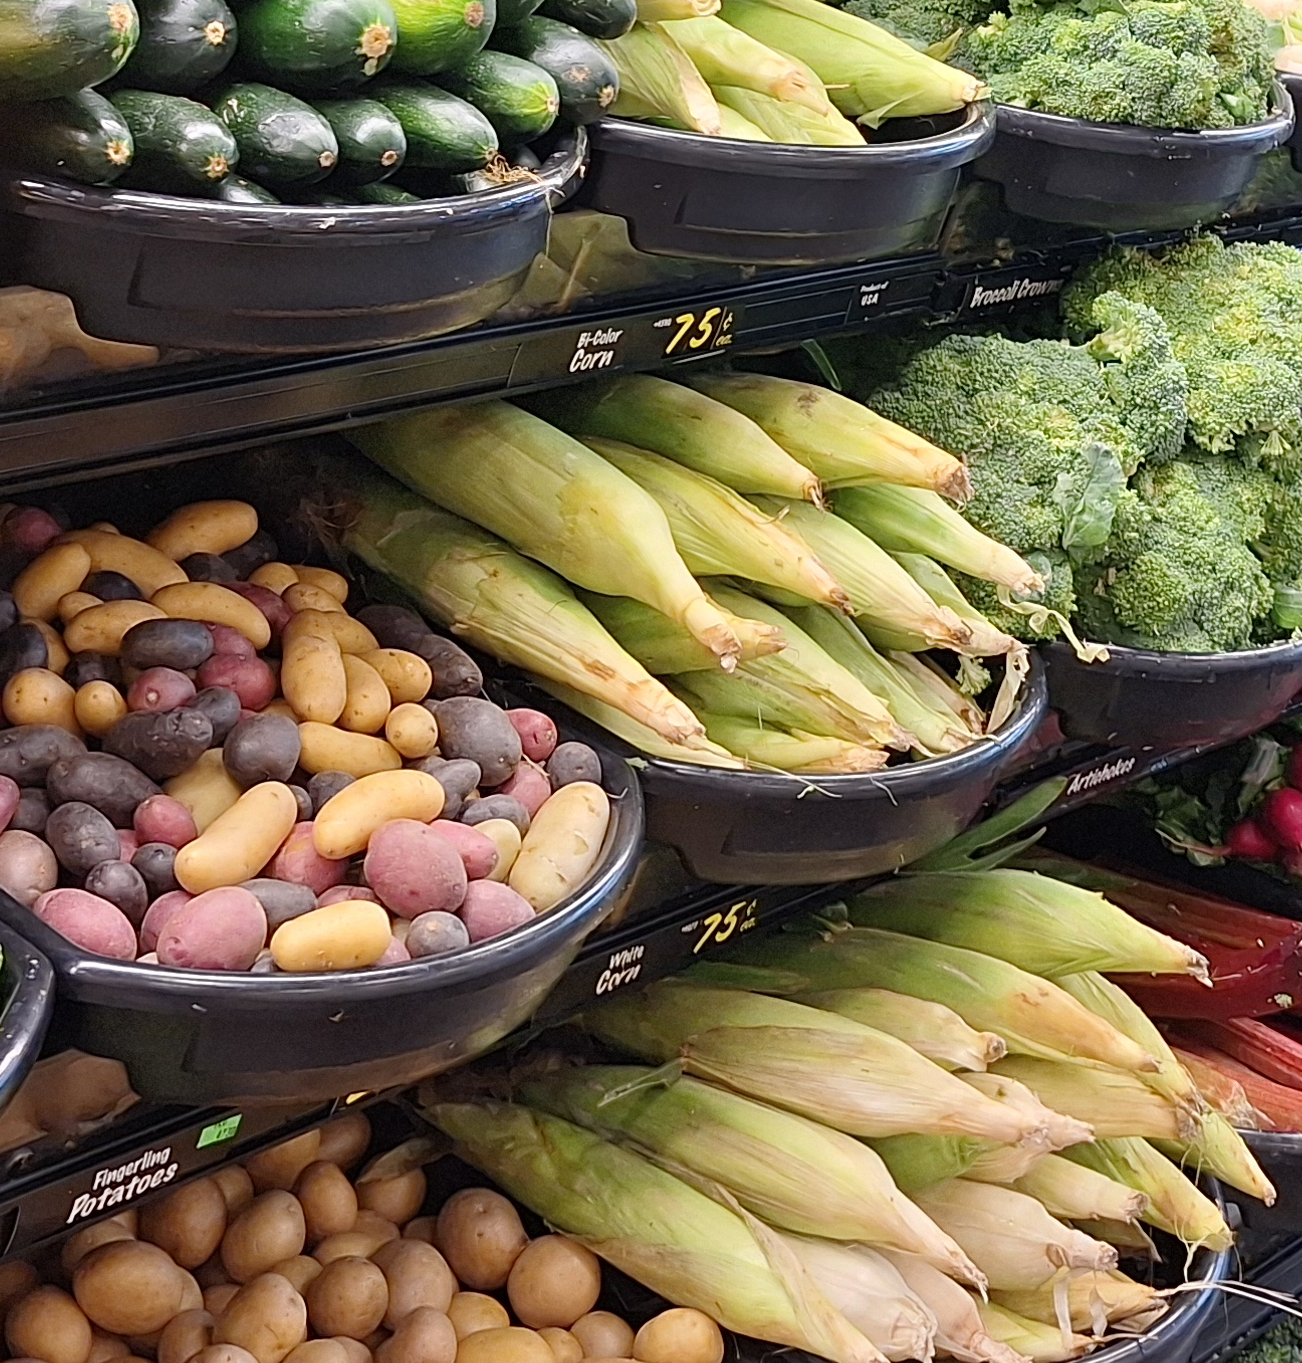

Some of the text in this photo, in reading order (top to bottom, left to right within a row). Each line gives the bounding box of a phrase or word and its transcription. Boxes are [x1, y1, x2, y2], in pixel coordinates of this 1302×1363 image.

[861, 292, 879, 306] USA
[970, 279, 1021, 309] Broccoli
[577, 328, 624, 348] Bi-Color
[569, 349, 614, 373] Corn
[609, 945, 645, 970] White
[596, 964, 641, 995] Corn
[93, 1147, 171, 1191] Fingerling
[66, 1162, 179, 1224] Potatoes
